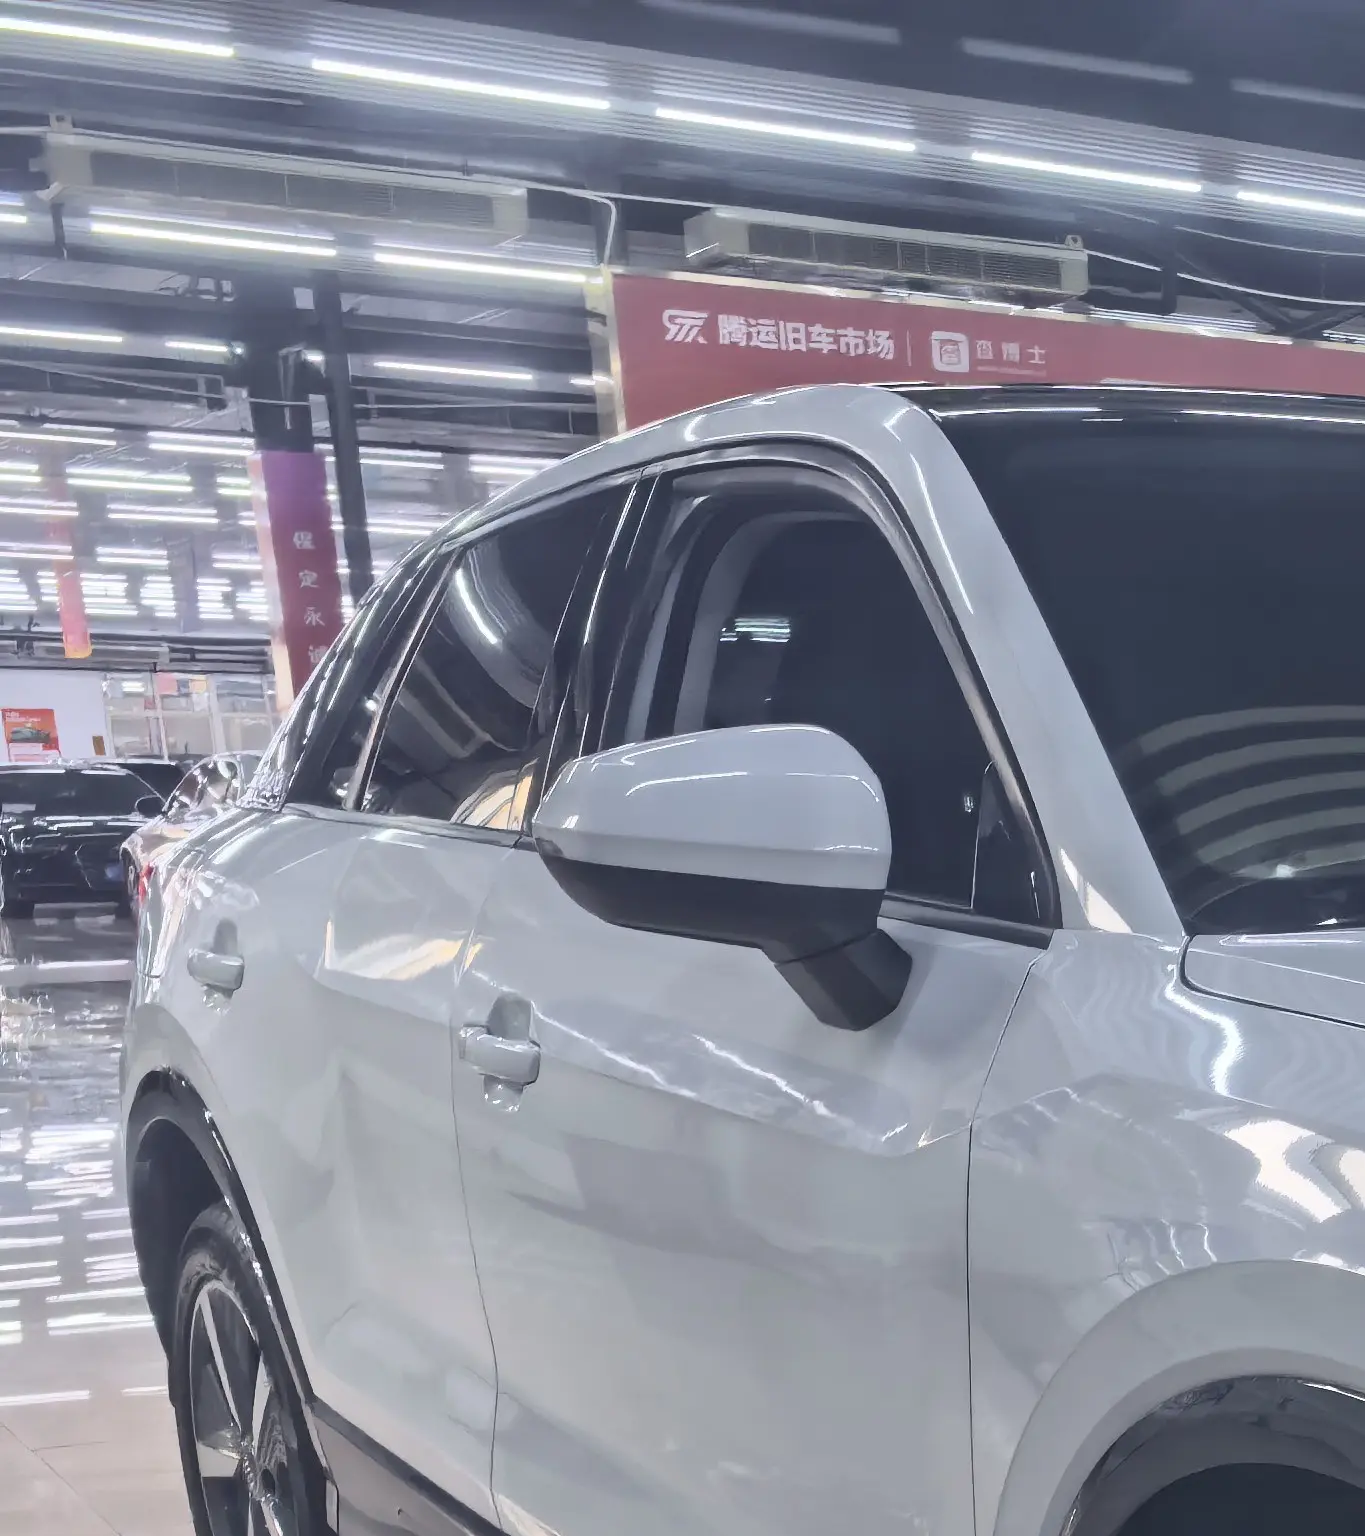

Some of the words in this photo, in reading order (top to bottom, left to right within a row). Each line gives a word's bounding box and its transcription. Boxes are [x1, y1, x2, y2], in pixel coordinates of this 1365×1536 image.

[717, 314, 895, 360] 腾运旧车市场
